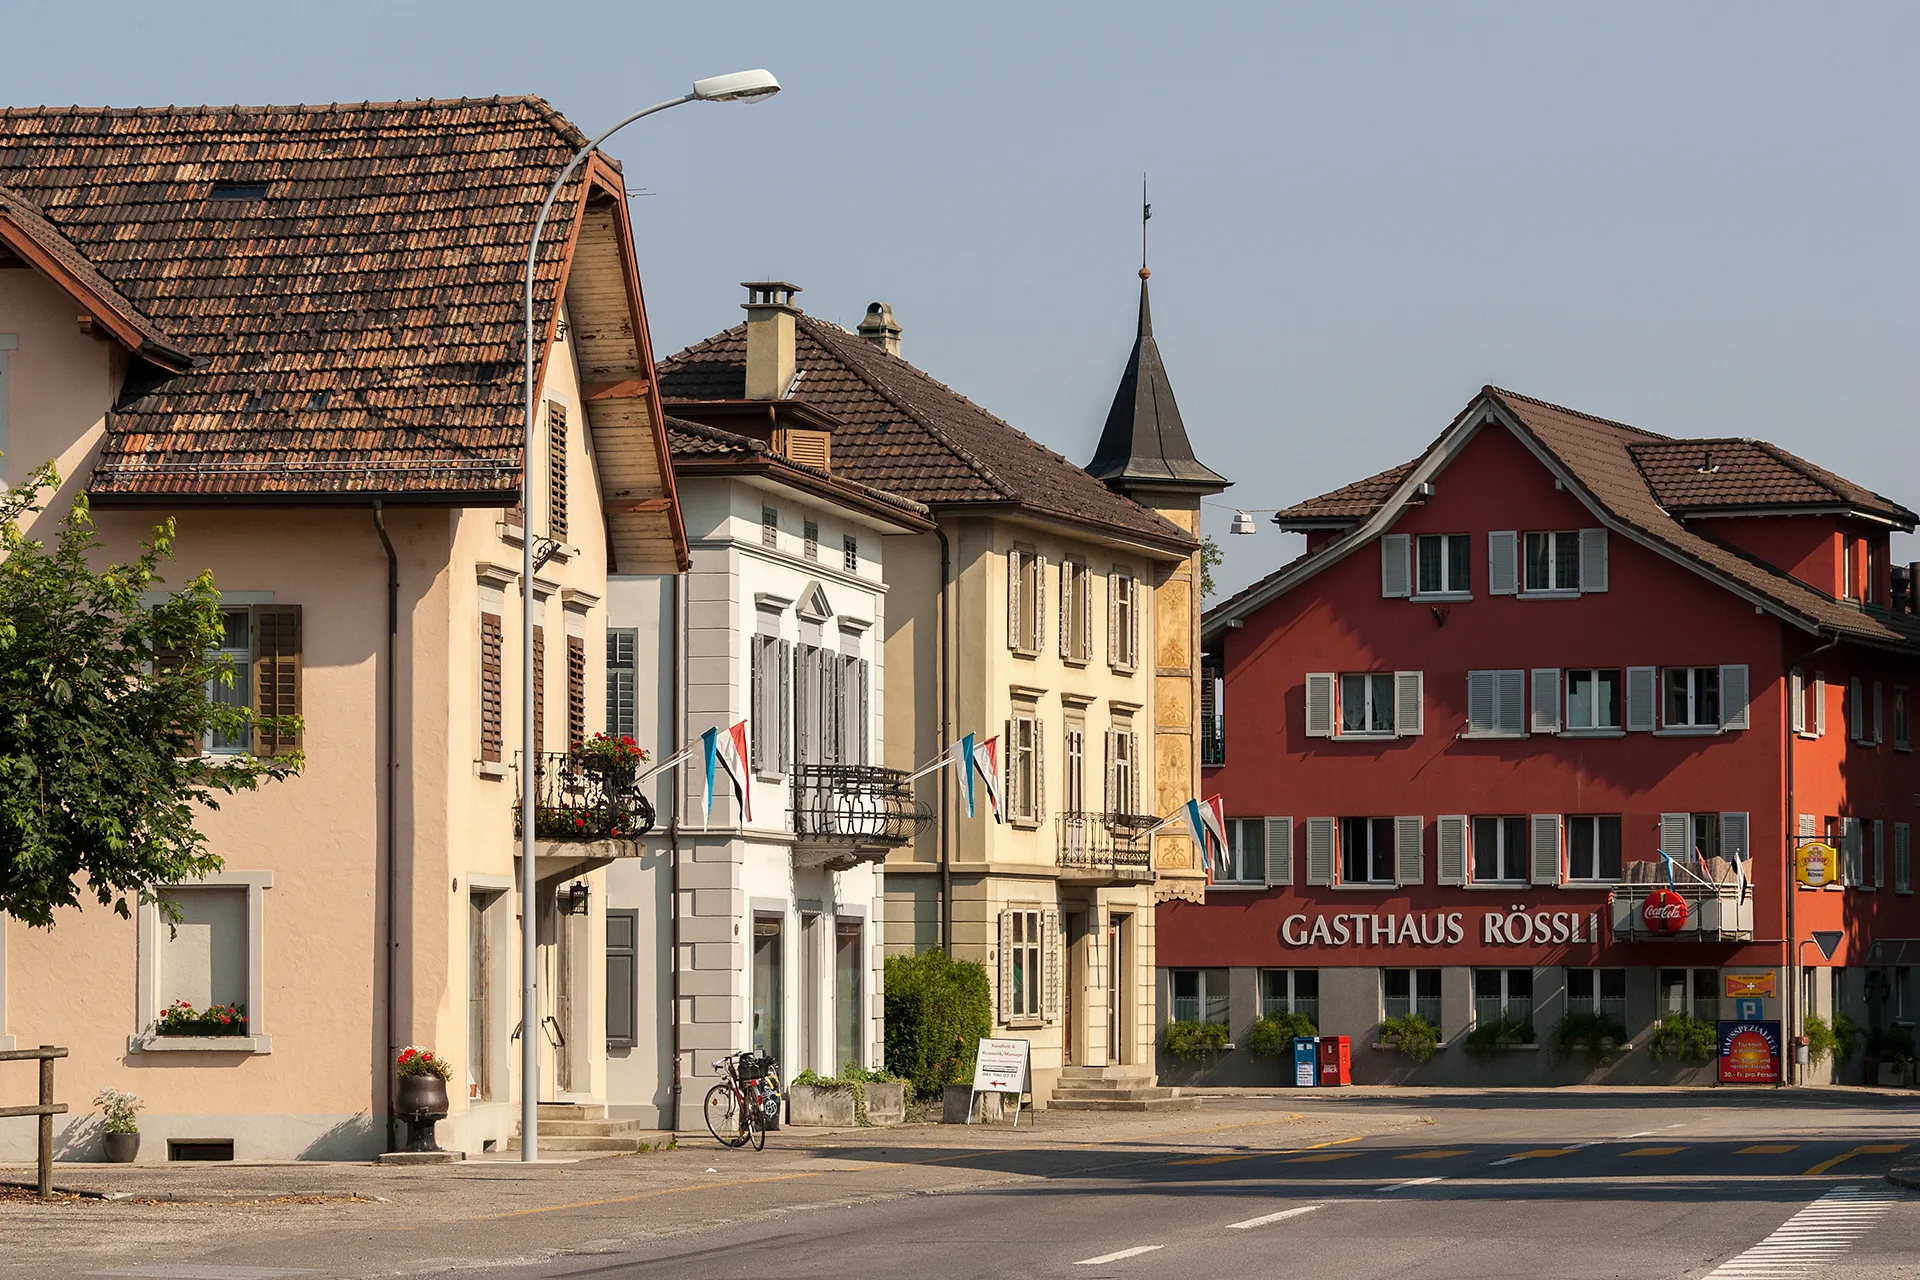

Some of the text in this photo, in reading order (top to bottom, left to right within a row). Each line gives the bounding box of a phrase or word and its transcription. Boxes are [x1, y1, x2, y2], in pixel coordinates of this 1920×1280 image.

[1282, 904, 1597, 945] GASTHAUS RÖSSLI
[1743, 1001, 1756, 1020] P
[1723, 1024, 1778, 1055] HAUSSPEZIALITÄT
